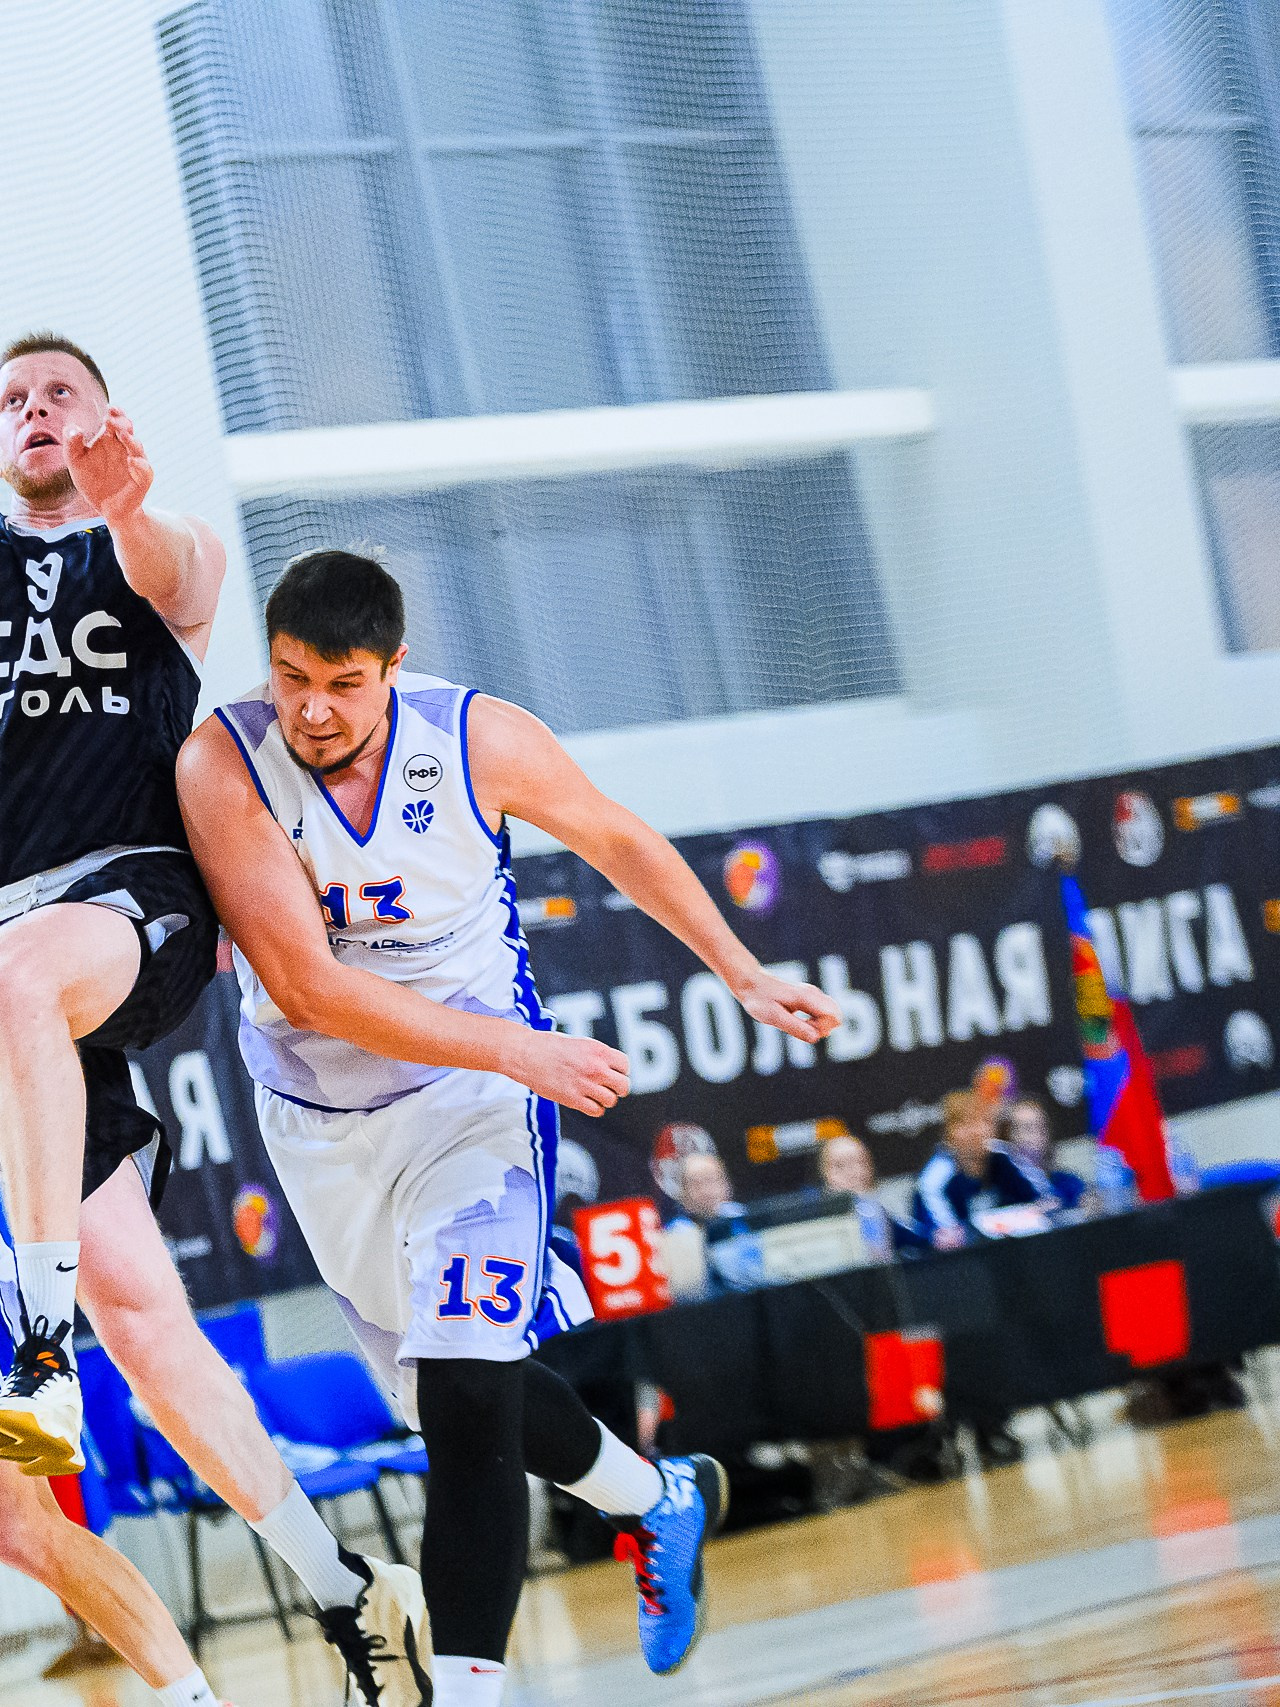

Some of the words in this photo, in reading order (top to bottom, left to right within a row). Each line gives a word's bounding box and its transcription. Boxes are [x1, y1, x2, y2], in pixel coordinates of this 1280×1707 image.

[25, 551, 63, 613] 9
[408, 766, 438, 779] РФБ
[436, 1253, 528, 1327] 13
